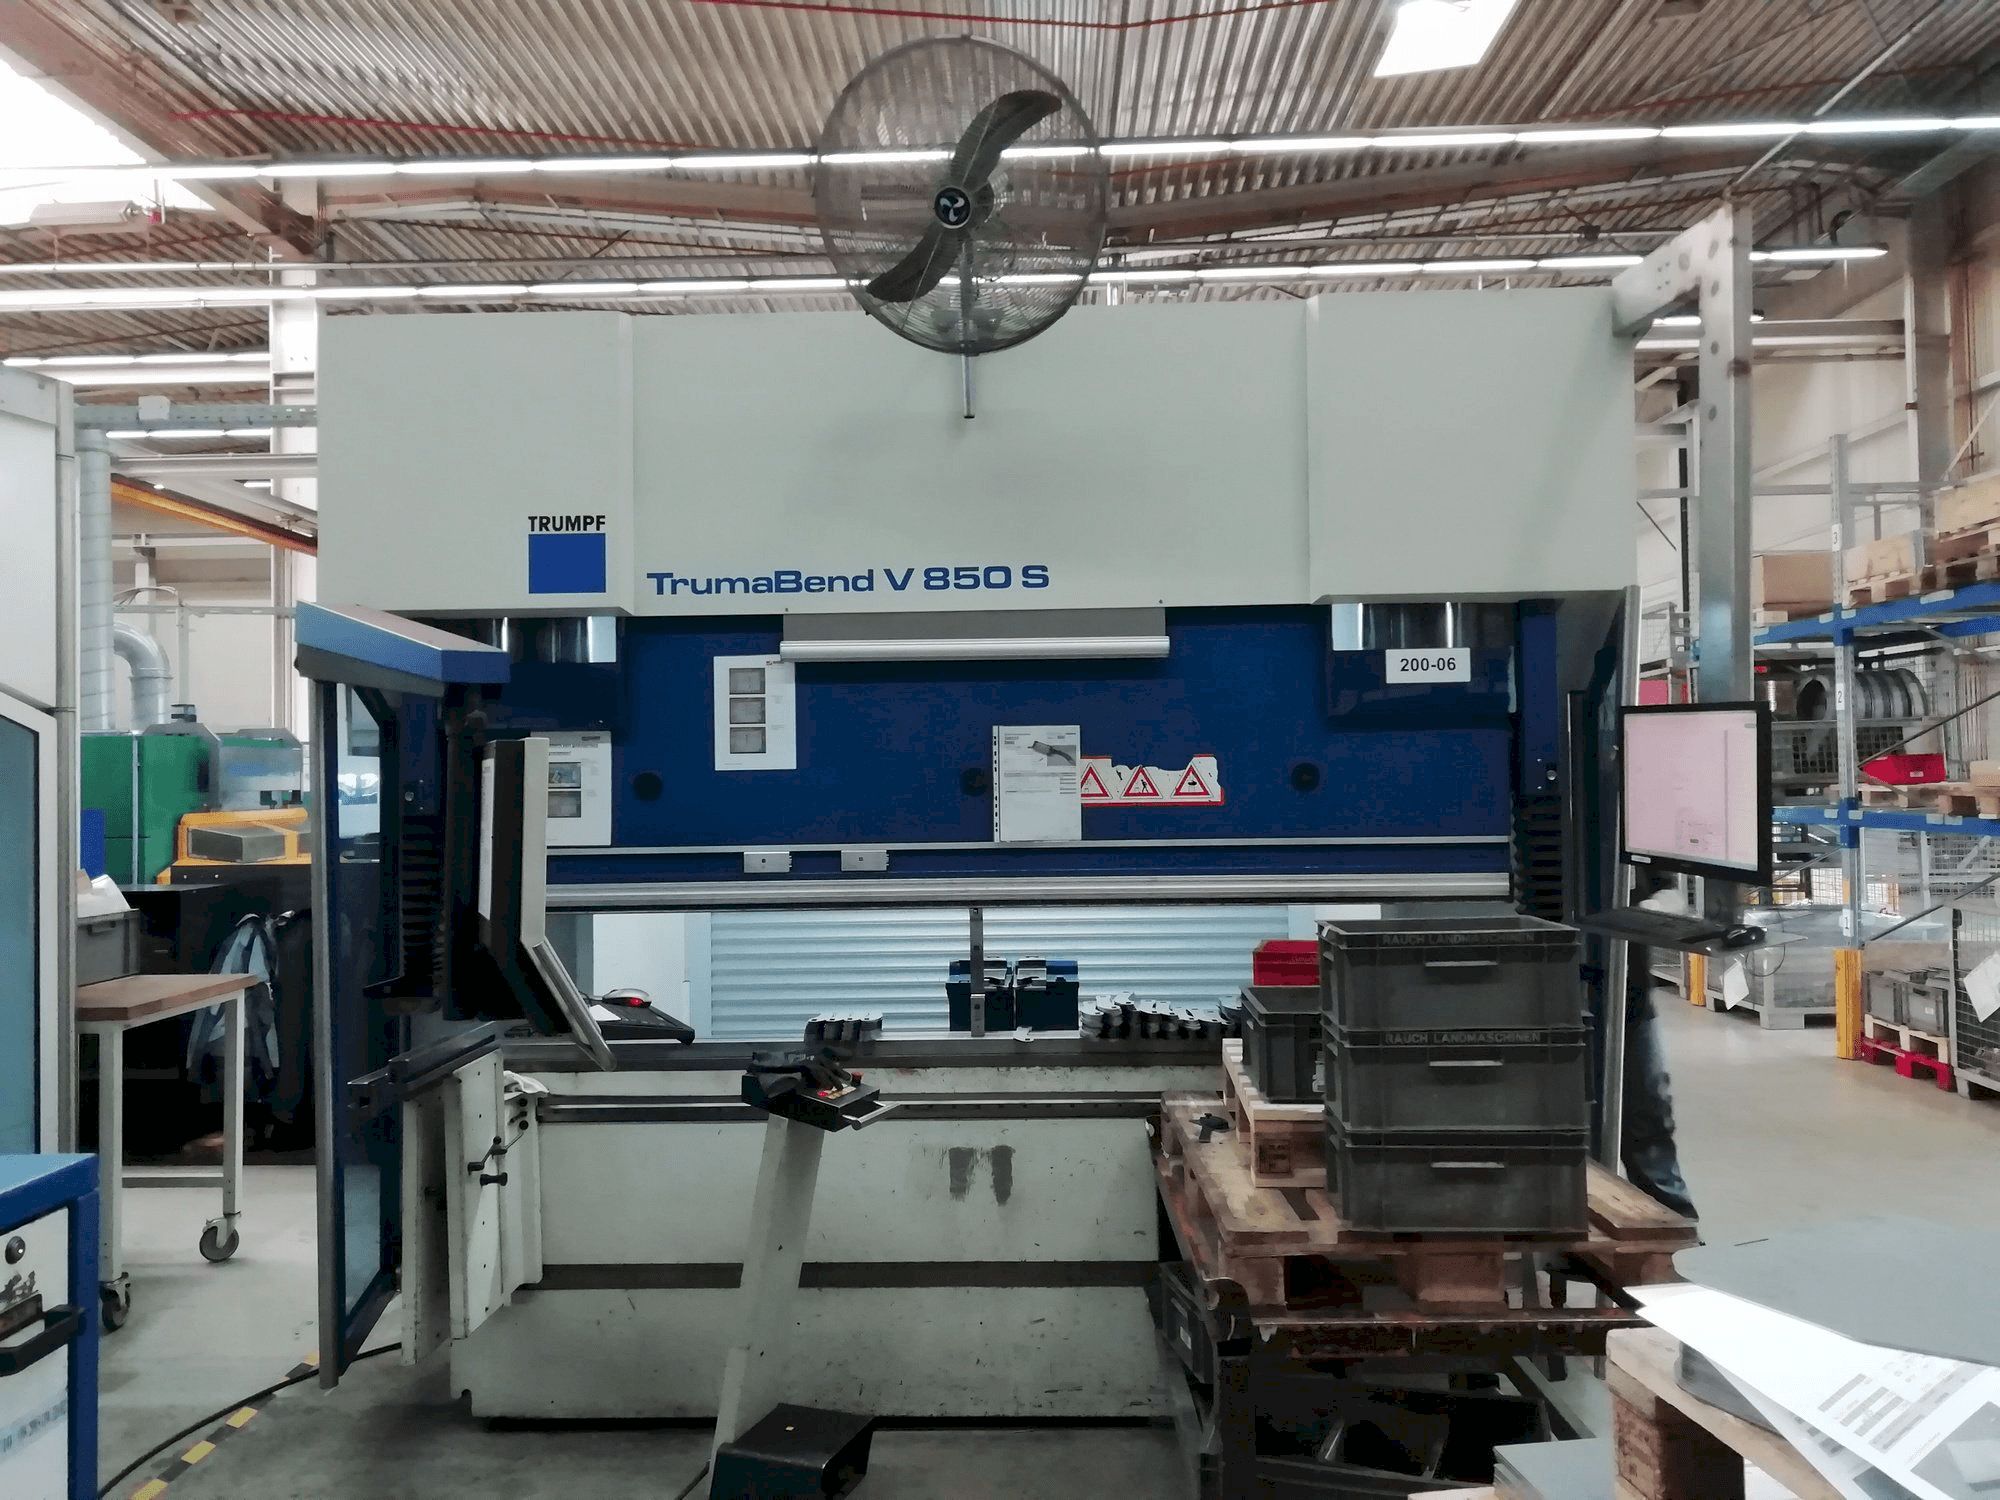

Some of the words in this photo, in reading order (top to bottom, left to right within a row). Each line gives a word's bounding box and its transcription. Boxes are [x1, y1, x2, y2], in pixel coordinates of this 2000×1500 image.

[527, 515, 606, 532] TRUMPF
[646, 568, 875, 596] TrumaBend
[883, 567, 915, 591] V
[923, 566, 1012, 590] 850
[1021, 565, 1050, 589] S
[1400, 657, 1457, 672] 200-06
[1837, 690, 1843, 704] 2
[1382, 934, 1425, 945] RAUCH
[1385, 1033, 1429, 1044] RAUCH
[1433, 1031, 1541, 1044] LANDMASCHINEN
